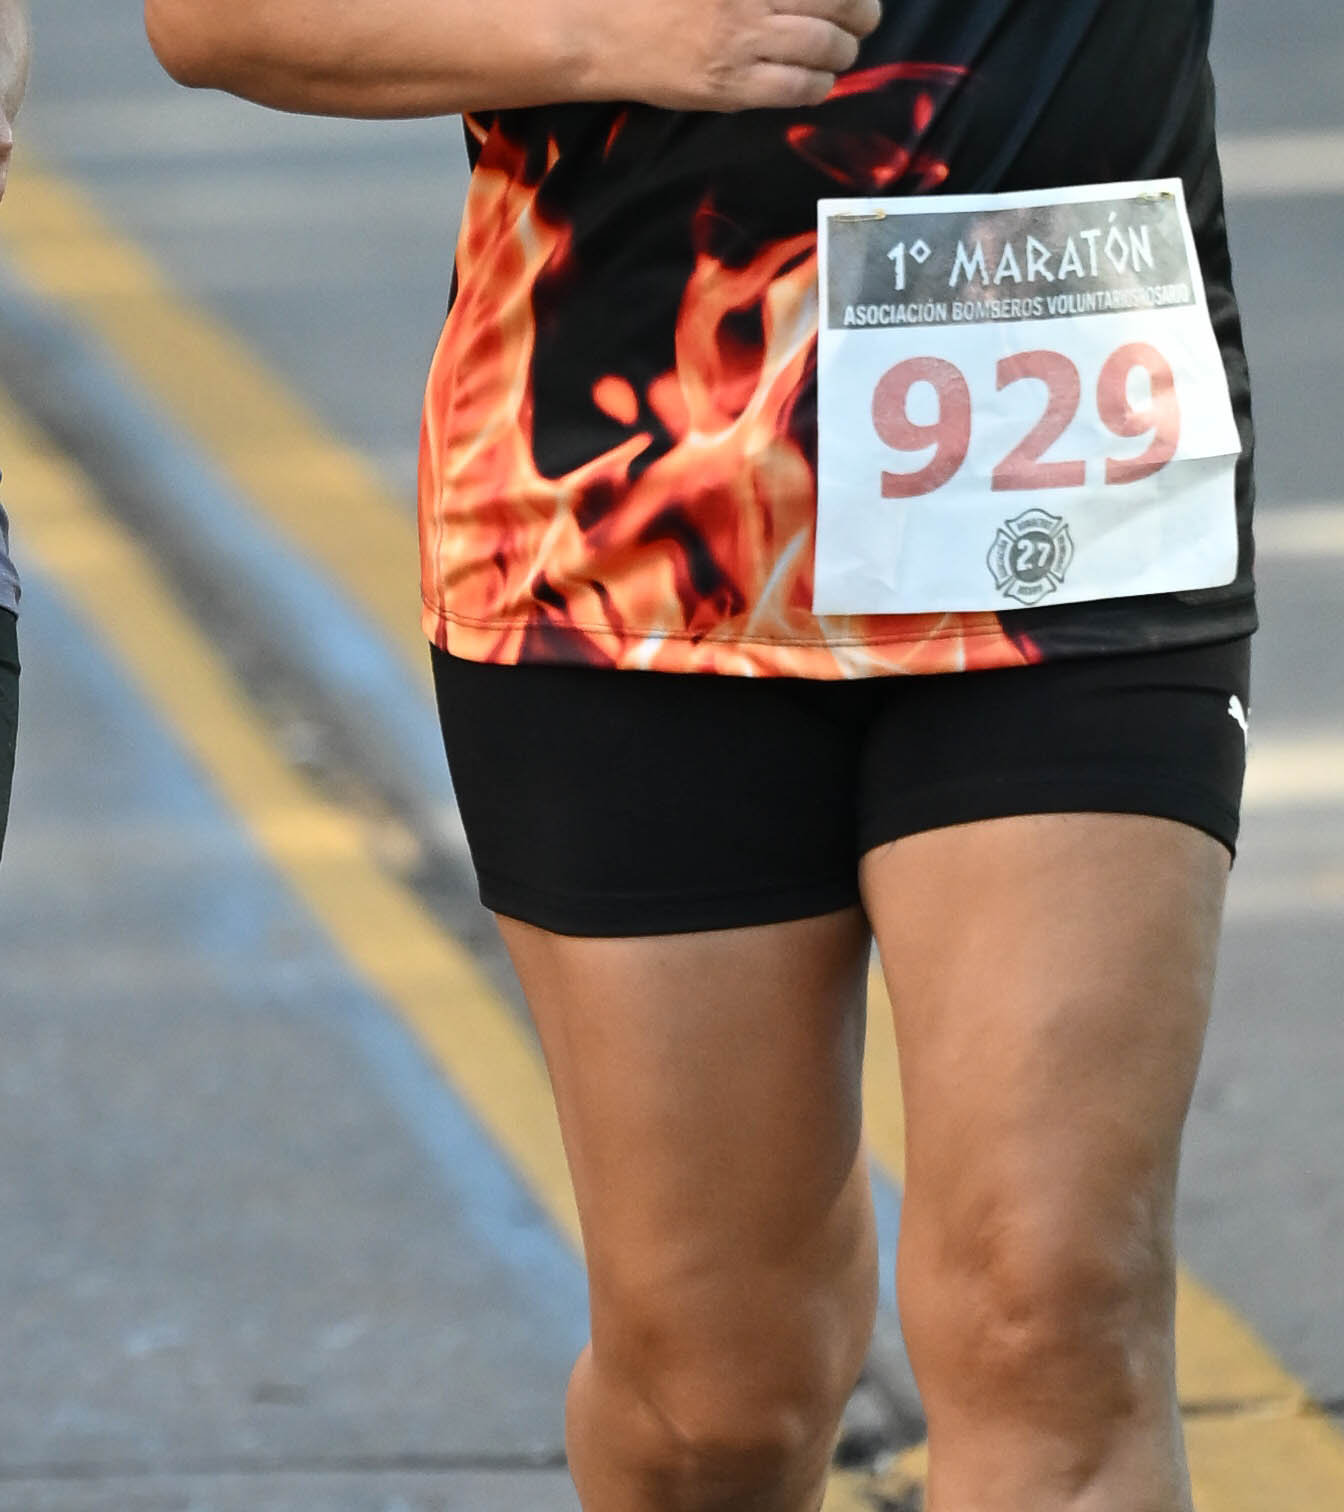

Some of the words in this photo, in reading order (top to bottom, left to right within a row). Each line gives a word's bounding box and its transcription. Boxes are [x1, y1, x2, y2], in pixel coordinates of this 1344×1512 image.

[947, 211, 1157, 289] MARATÓN
[842, 299, 948, 327] ASOCIACIÓN
[951, 295, 1044, 322] BOMBEROS
[871, 342, 1181, 499] 929
[1016, 538, 1051, 572] 27
